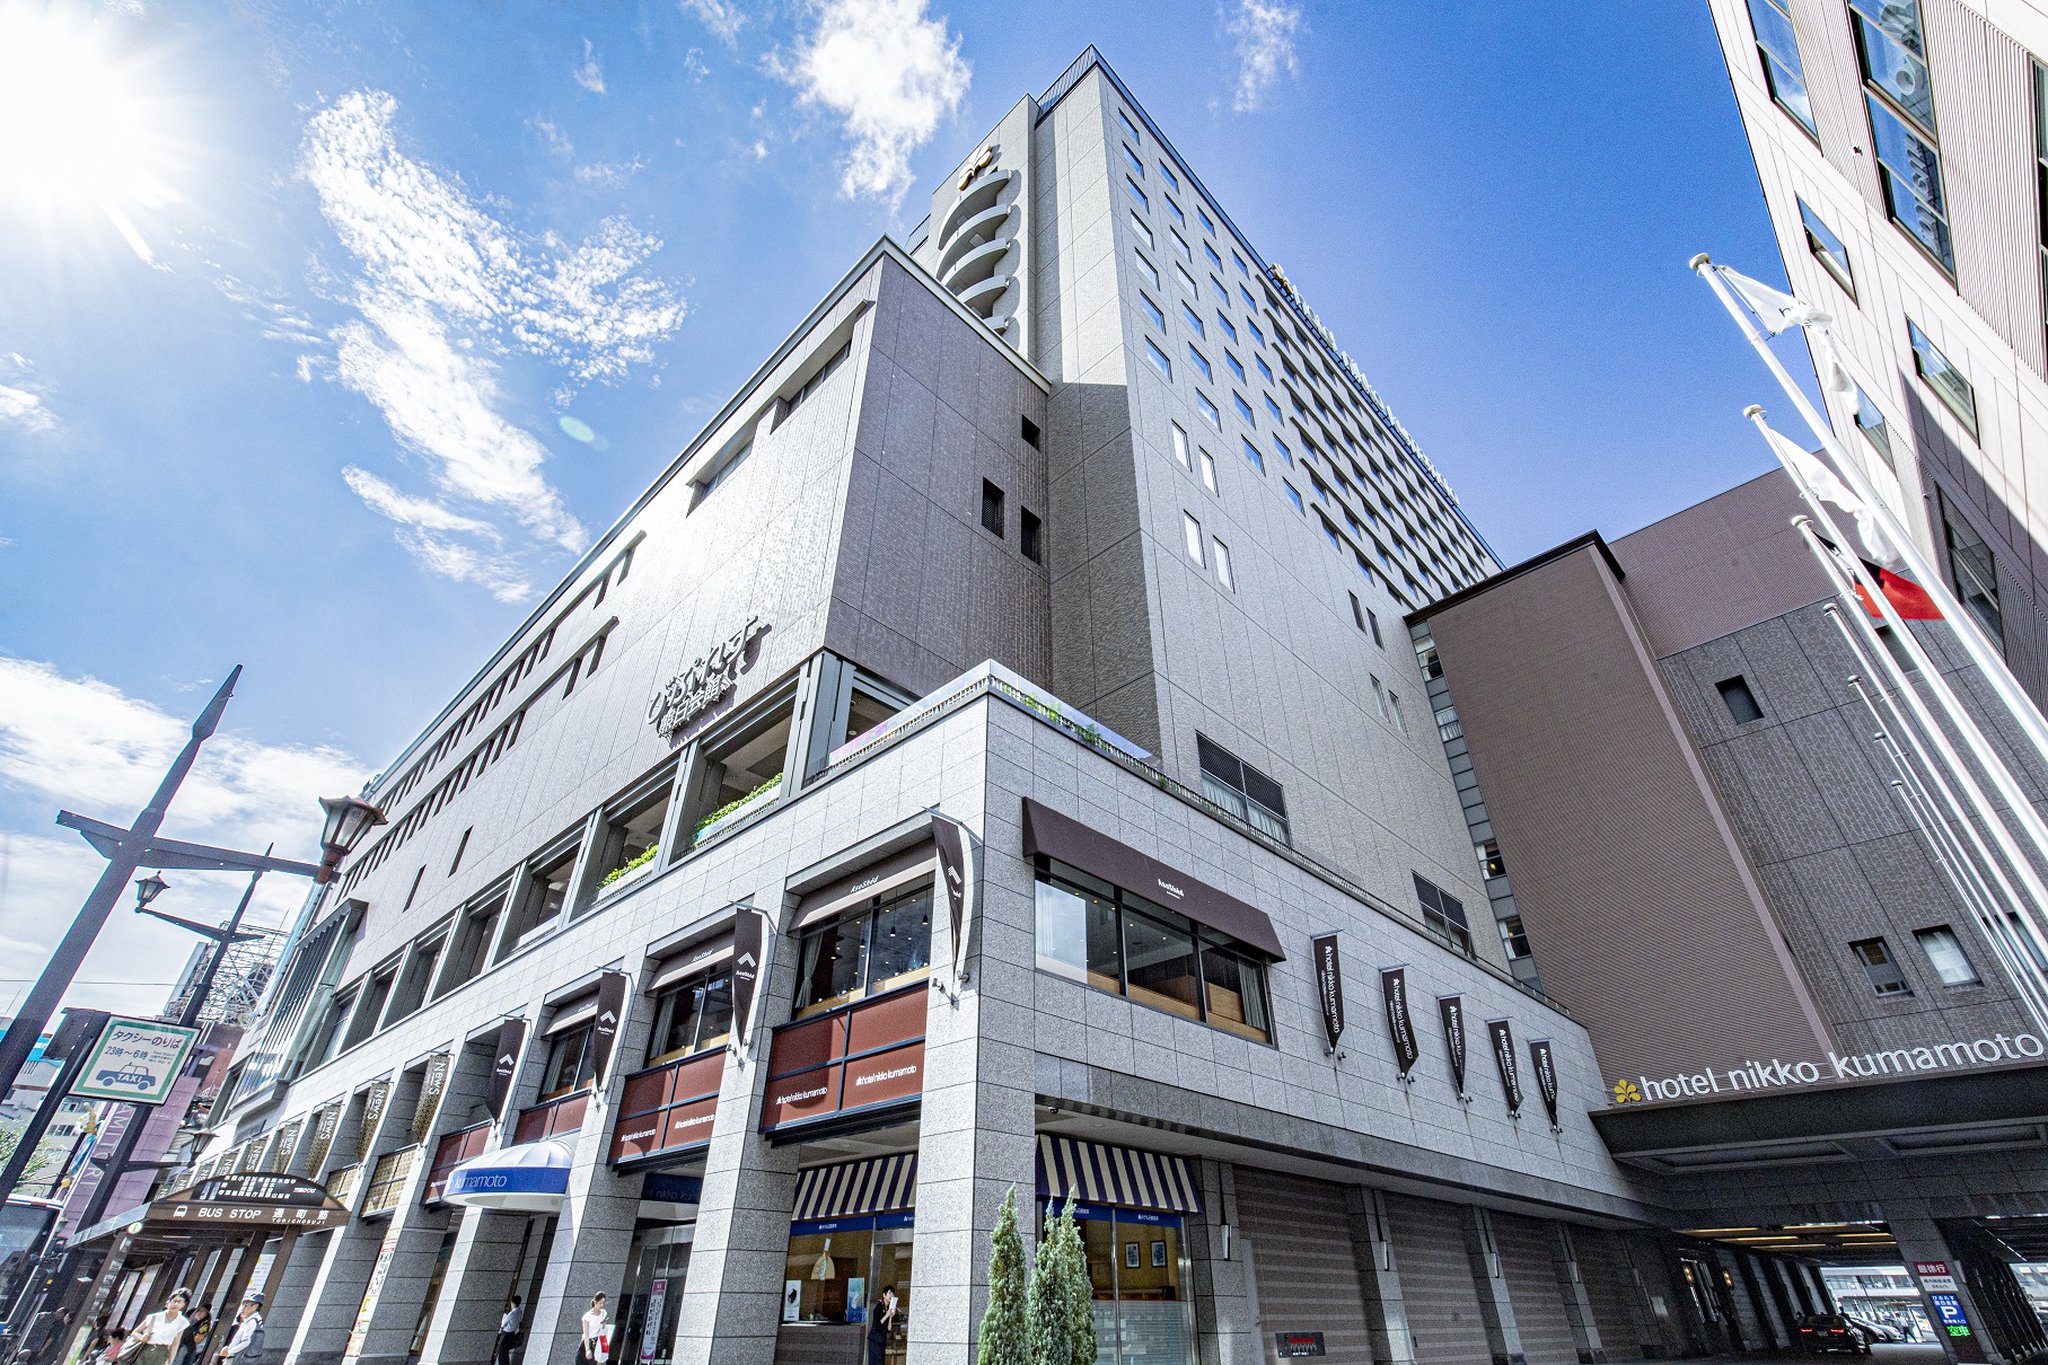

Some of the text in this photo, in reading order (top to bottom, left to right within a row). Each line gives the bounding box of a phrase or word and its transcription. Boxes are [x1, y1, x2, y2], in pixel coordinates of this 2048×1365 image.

[1325, 953, 1334, 971] hotel
[1329, 991, 1340, 1033] kumamoto
[111, 1030, 183, 1049] タクシーのりば
[1398, 1020, 1413, 1059] kumamoto
[888, 1064, 917, 1079] kumamoto
[1639, 1032, 2045, 1101] hotel nikko kumamoto
[117, 1073, 142, 1082] TAXI
[80, 1103, 131, 1185] AMITORI
[454, 1174, 508, 1189] kumamoto
[197, 1207, 262, 1219] BUS STOP
[1940, 1305, 1958, 1319] P
